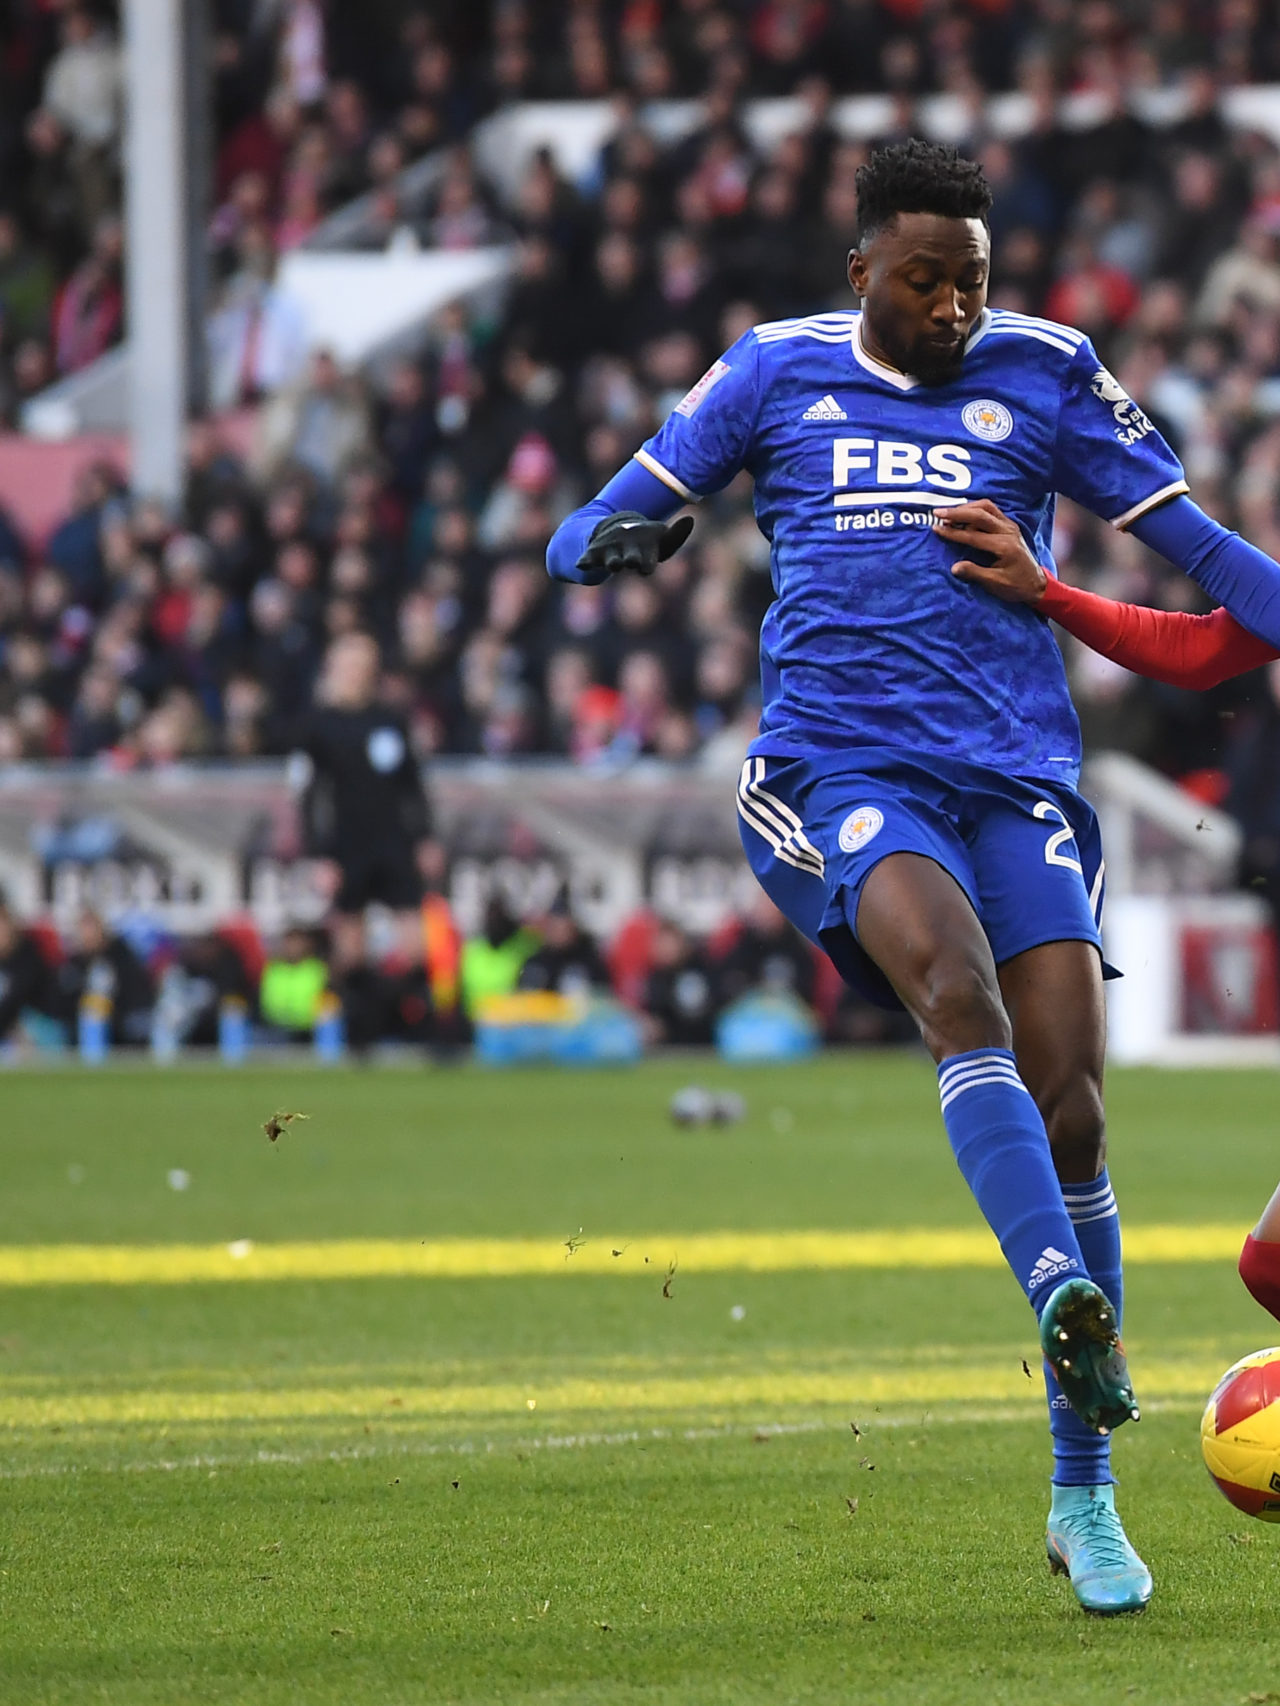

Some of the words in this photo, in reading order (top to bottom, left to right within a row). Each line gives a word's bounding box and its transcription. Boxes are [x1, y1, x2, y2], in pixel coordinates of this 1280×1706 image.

[802, 410, 848, 421] adidas
[833, 438, 972, 491] FBS
[835, 508, 895, 532] trade
[1032, 800, 1083, 875] 2
[1028, 1258, 1078, 1289] adidas
